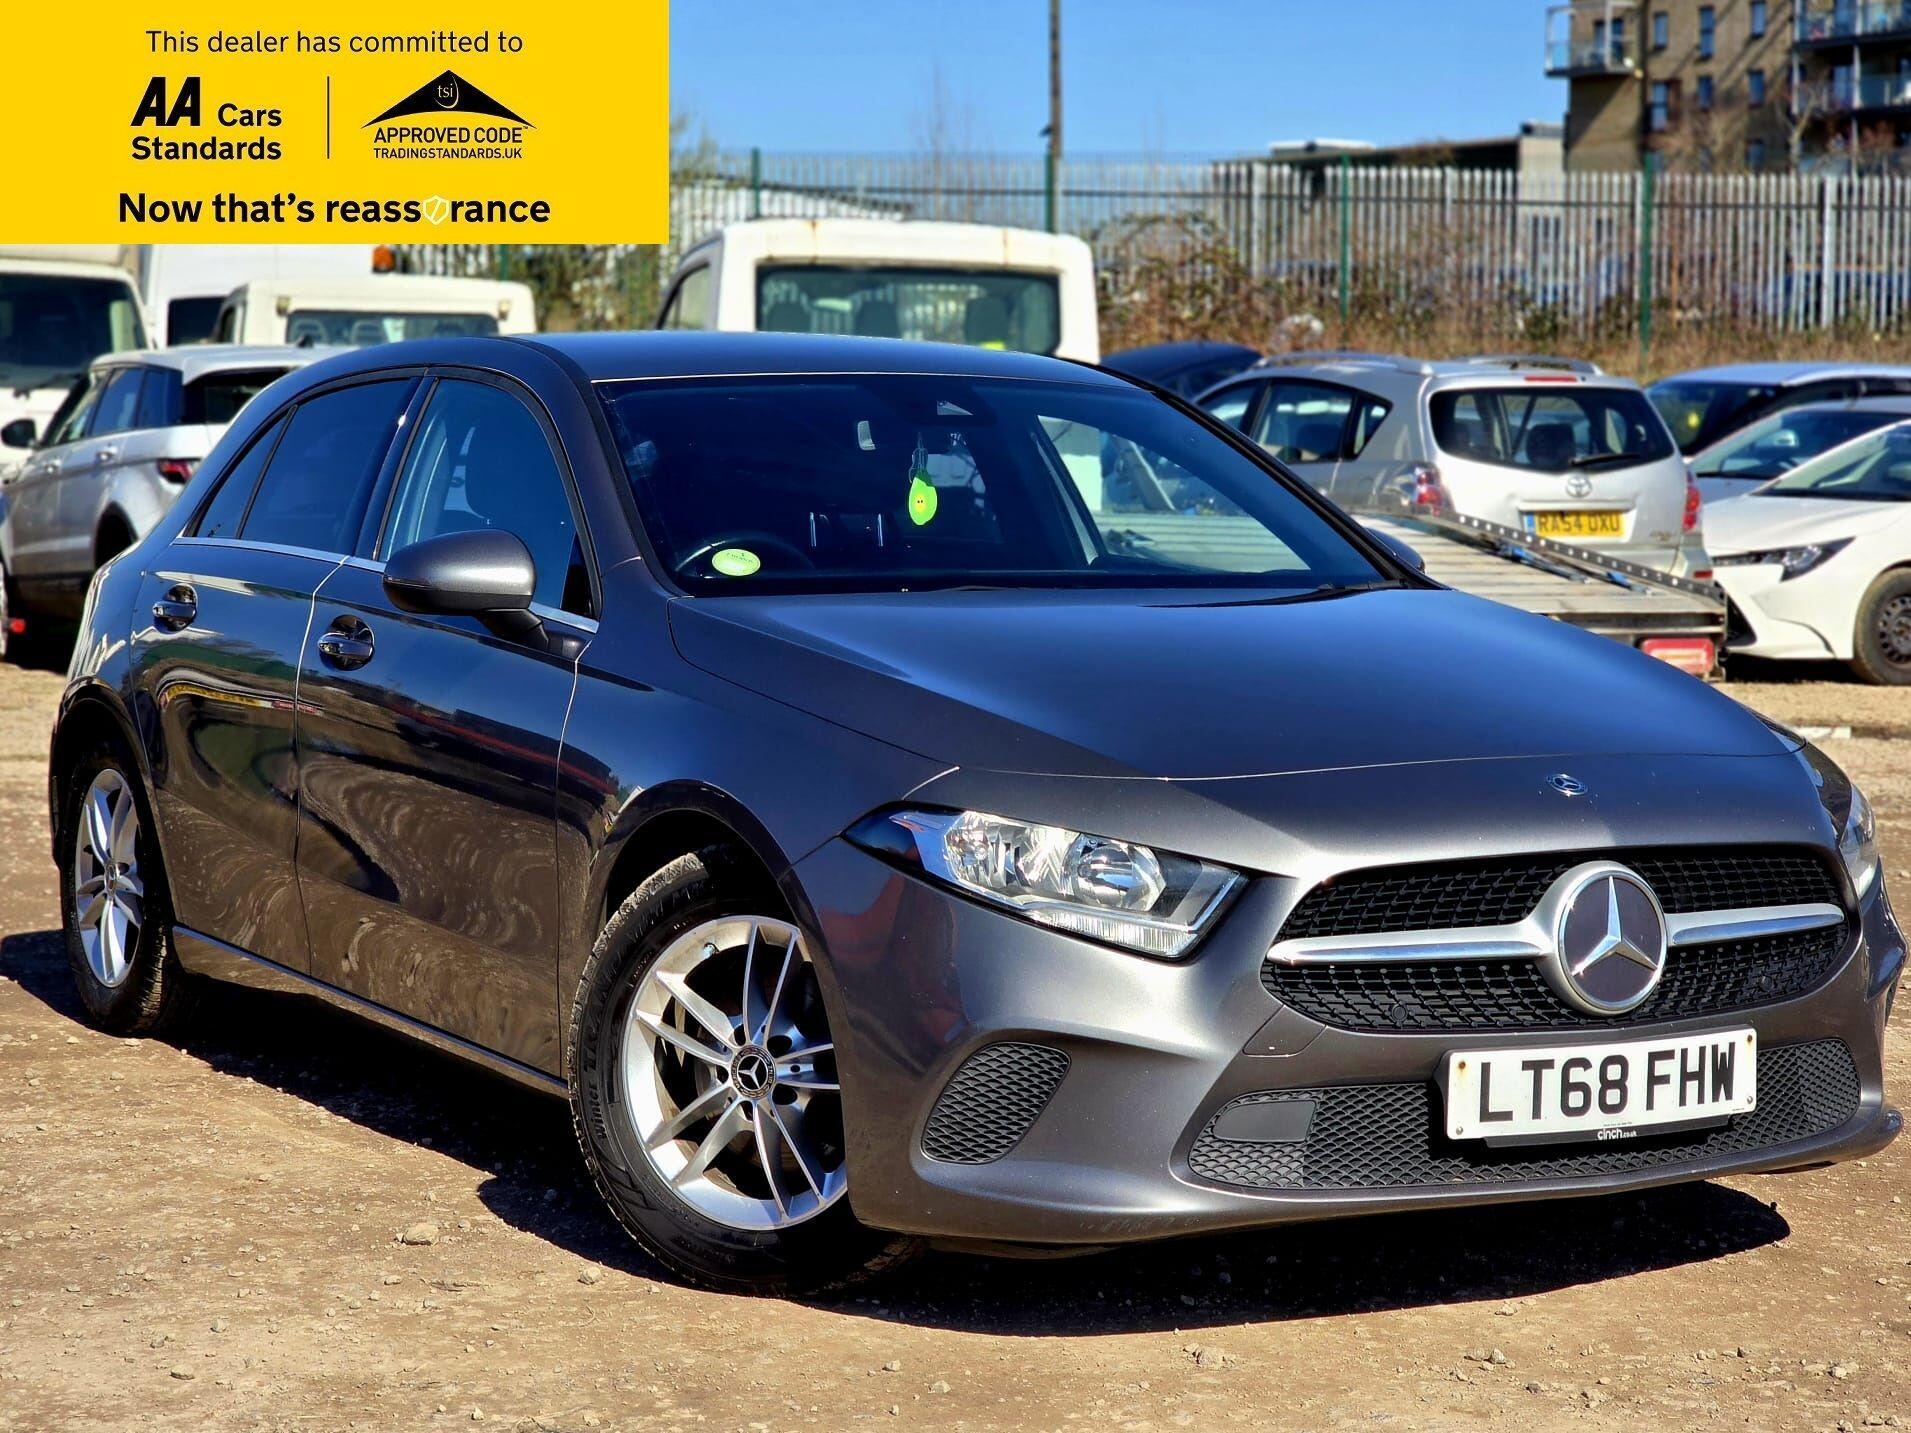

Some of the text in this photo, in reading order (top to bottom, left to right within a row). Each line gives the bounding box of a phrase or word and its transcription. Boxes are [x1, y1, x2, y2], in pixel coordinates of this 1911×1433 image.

[1540, 511, 1583, 532] RA54
[1479, 1041, 1736, 1122] LT68 FHW
